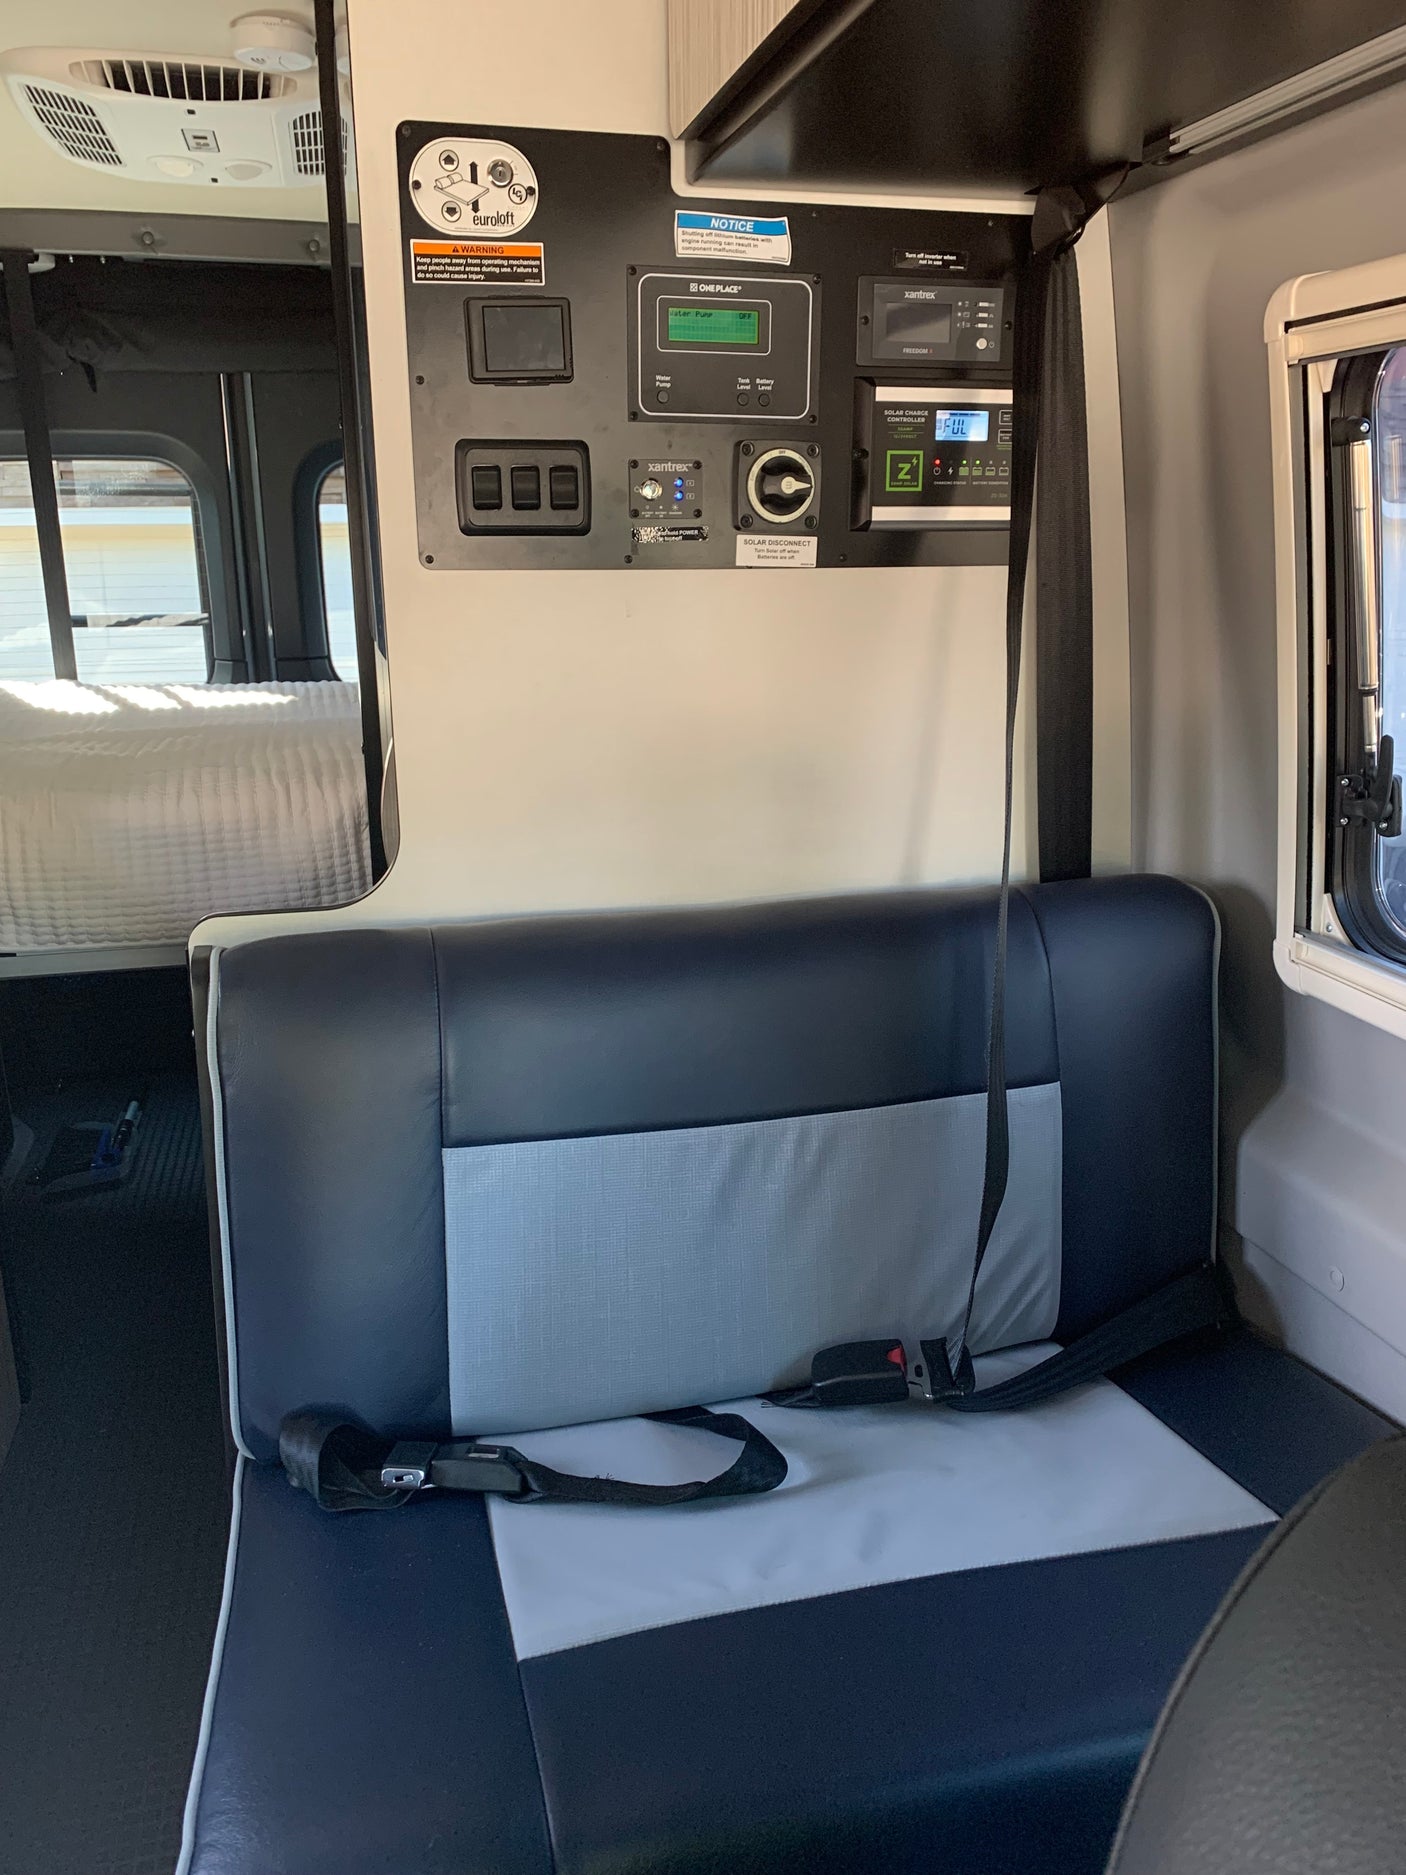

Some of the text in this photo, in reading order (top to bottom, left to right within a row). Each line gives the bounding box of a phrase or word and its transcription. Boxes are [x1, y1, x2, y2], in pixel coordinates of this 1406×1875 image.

[473, 211, 515, 226] euroloft
[710, 218, 754, 232] NOTICE
[461, 246, 504, 254] WARNING
[904, 290, 935, 299] xantrex
[648, 462, 689, 471] xantrex
